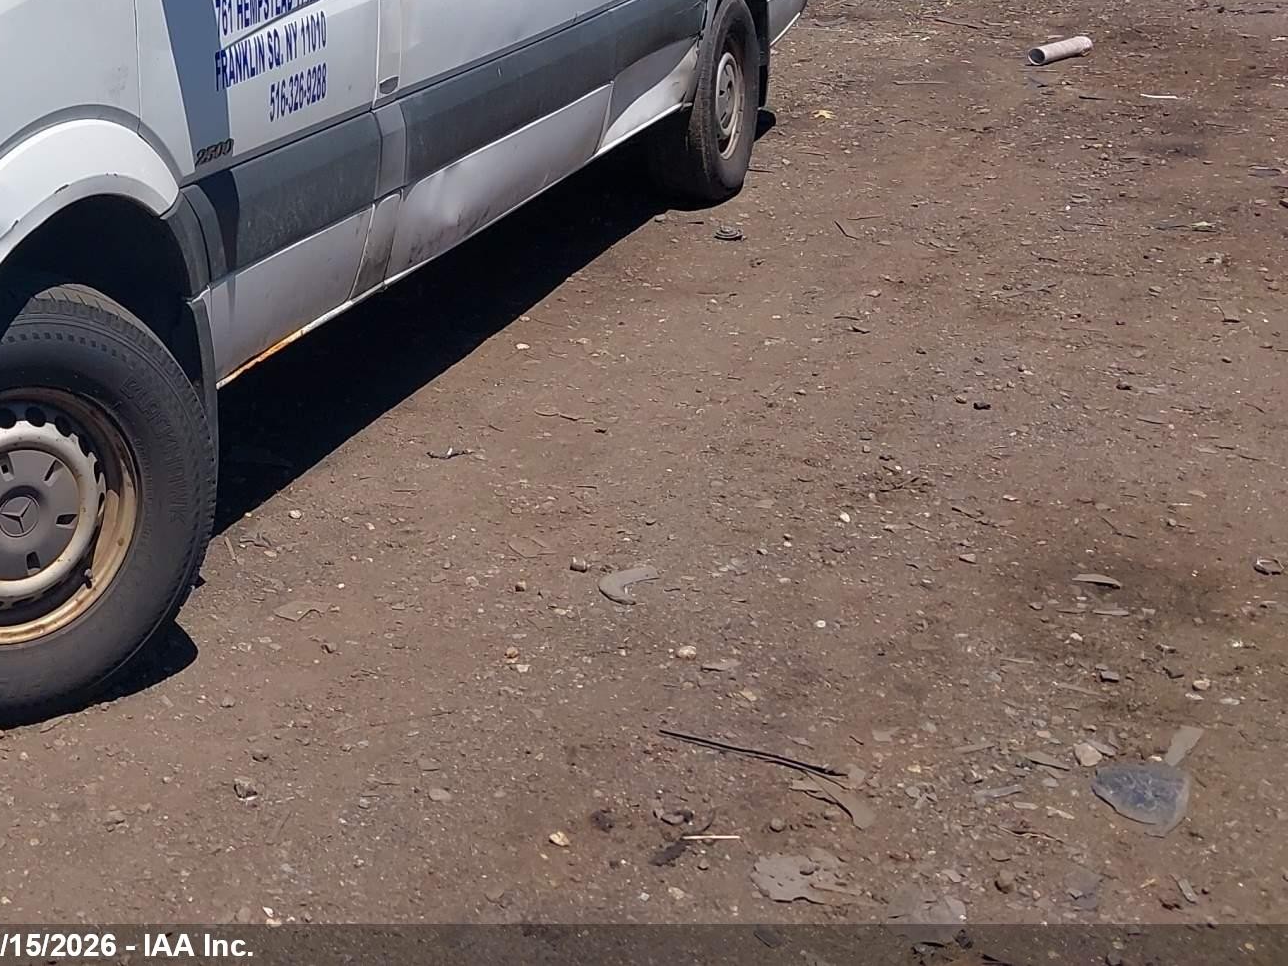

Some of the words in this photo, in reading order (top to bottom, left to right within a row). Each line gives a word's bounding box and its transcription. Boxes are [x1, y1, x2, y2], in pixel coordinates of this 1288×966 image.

[215, 38, 266, 92] FRANKLIN
[284, 21, 298, 63] NY
[300, 10, 327, 56] 11010
[269, 62, 327, 122] 516-326-9288
[195, 138, 234, 166] 2500
